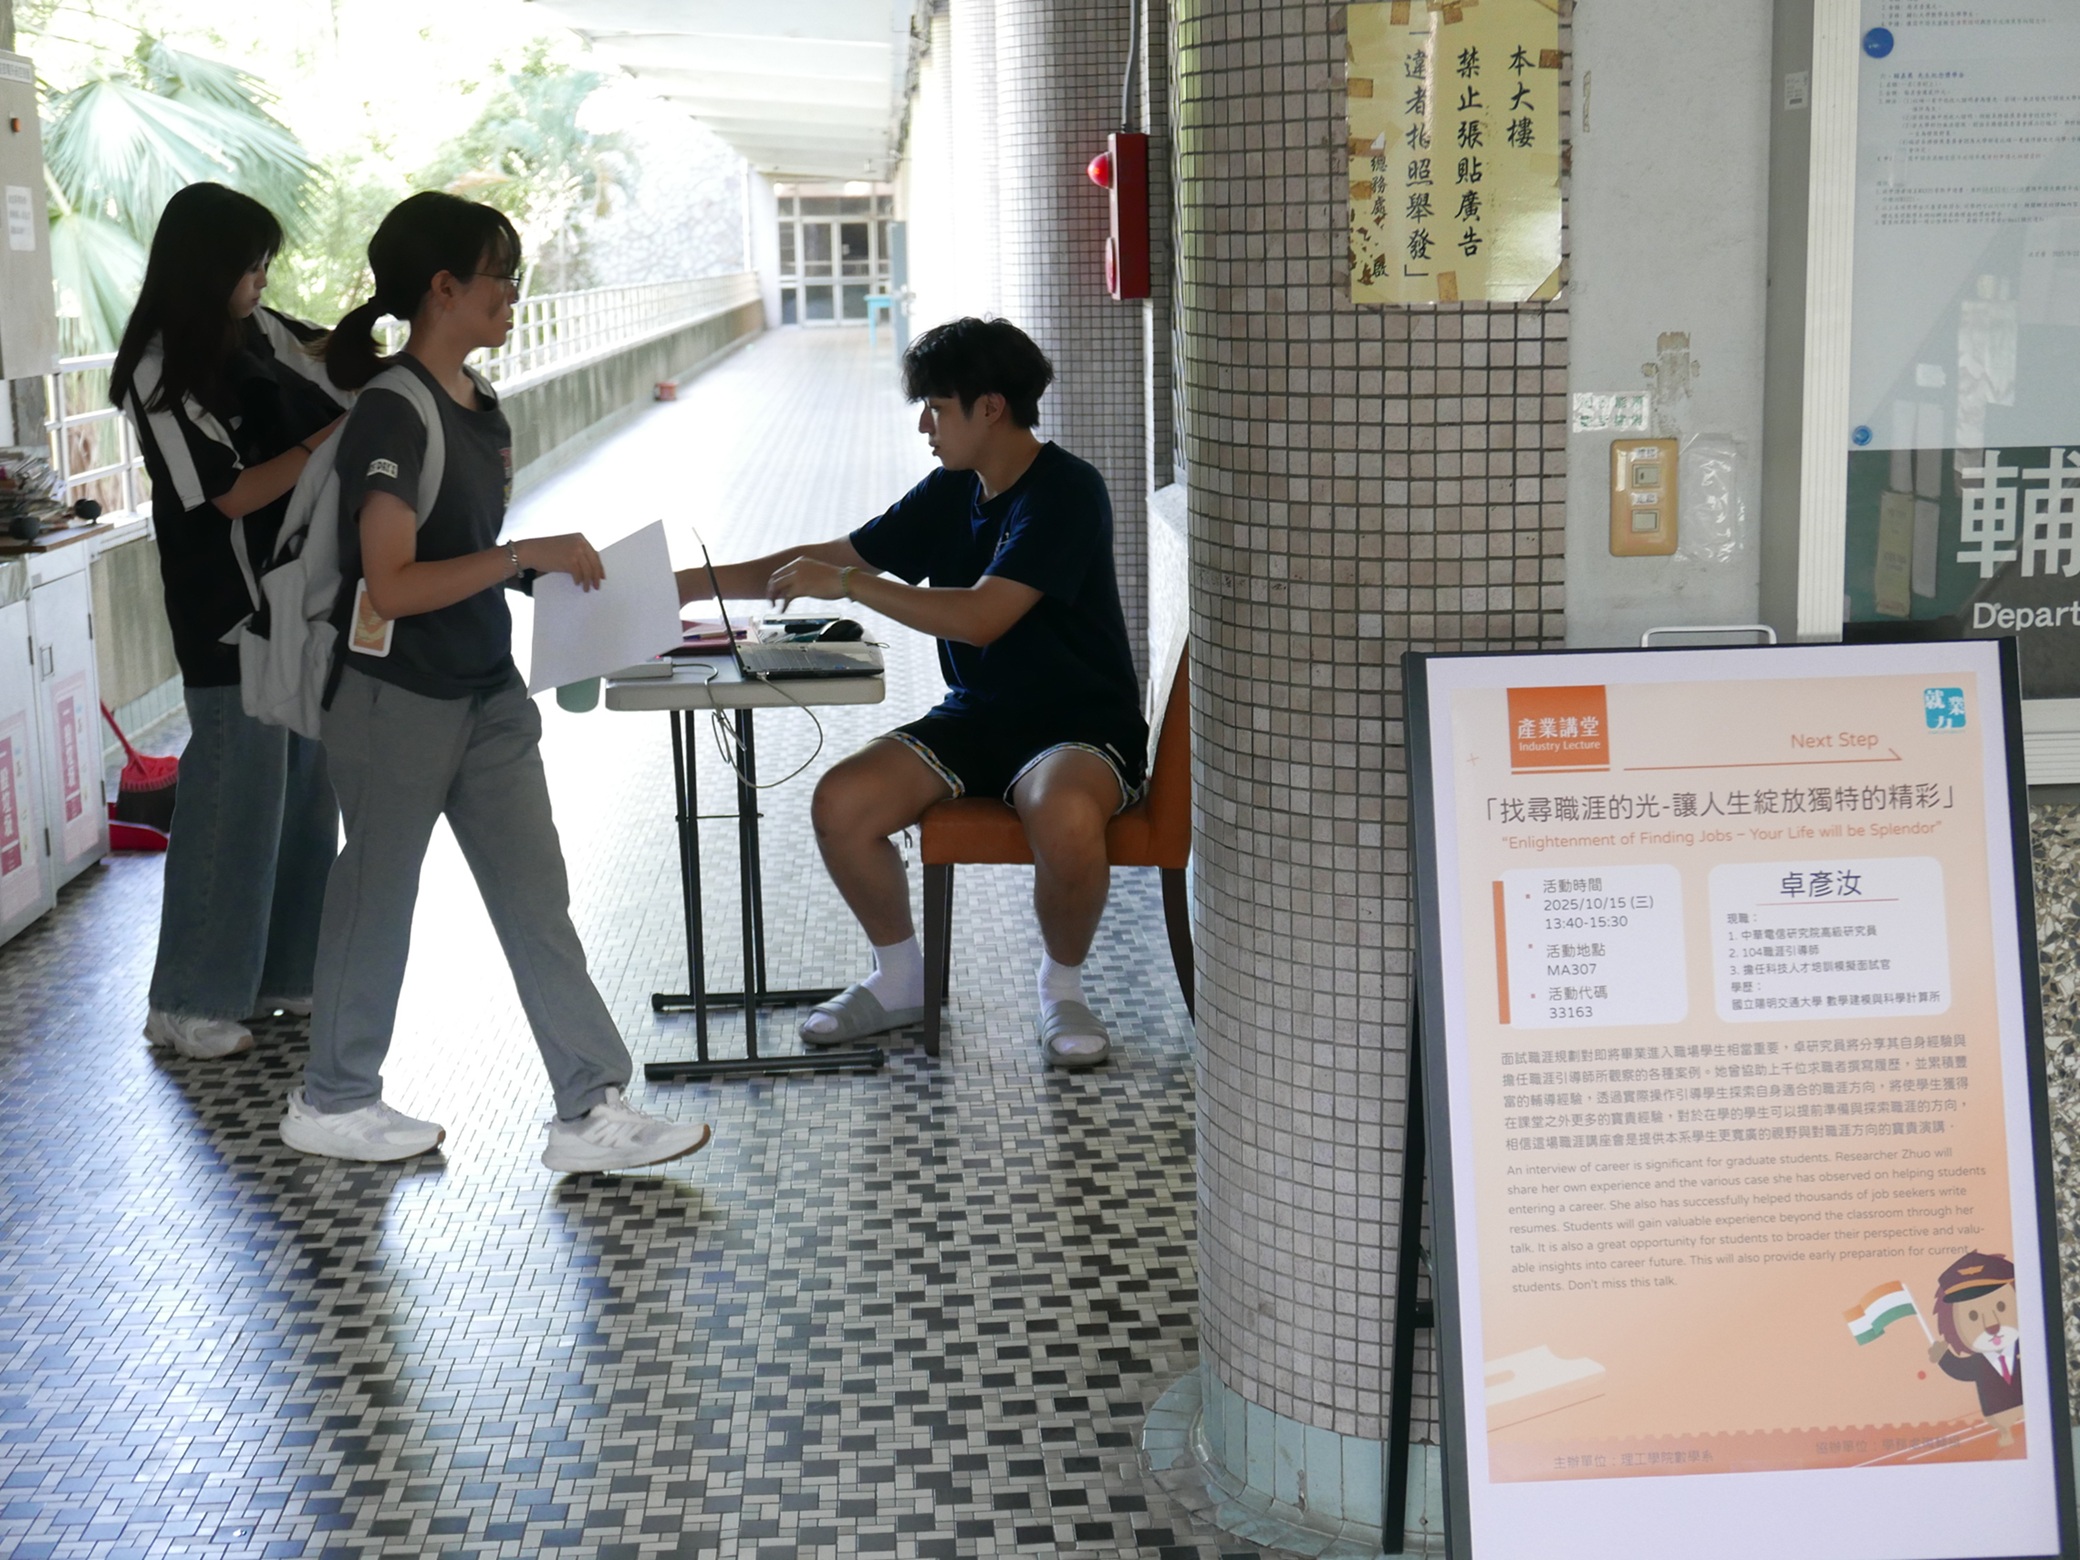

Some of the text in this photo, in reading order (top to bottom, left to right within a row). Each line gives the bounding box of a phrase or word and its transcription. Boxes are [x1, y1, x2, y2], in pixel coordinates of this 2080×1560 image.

[1507, 44, 1536, 149] 本大樓
[1454, 46, 1483, 257] 禁止張貼廣告
[1517, 715, 1599, 740] 產業講堂
[1518, 740, 1600, 752] Industry Lecture
[1790, 731, 1879, 749] Next Step
[1619, 831, 1635, 845] of
[1639, 831, 1694, 847] Finding
[1698, 829, 1733, 843] Jobs
[1748, 827, 1783, 840] Your
[1787, 825, 1814, 839] Life
[1818, 824, 1842, 837] will
[1846, 824, 1865, 837] be
[1543, 877, 1602, 893] 活動時間
[1780, 869, 1861, 897] 卓彥汝
[1543, 895, 1654, 911] 2025/10/15 (三)
[1545, 915, 1628, 929] 13:40-15:30
[1728, 931, 1738, 941] 1.
[1546, 942, 1605, 958] 活動地點
[1728, 947, 1739, 958] 2.
[1547, 962, 1597, 976] MA307
[1729, 965, 1741, 975] 3.
[1548, 984, 1607, 1001] 活動代碼
[1549, 1005, 1593, 1019] 33163
[1506, 1147, 1952, 1175] An interview of career is significant for graduate students. Researcher Zhuo will
[1506, 1166, 1986, 1195] share her own experience and the various case she has observed on helping students
[1507, 1186, 1967, 1216] entering a career. She also has successfully helped thousands of job seekers write
[1508, 1205, 1974, 1234] resumes. Students will gain valuable experience beyond the classroom through her
[1509, 1223, 1985, 1254] talk. It is also a great opportunity for students to broader their perspective and valu-
[1511, 1245, 1969, 1274] able insights into career future. This will also provide early preparation for current
[1511, 1275, 1678, 1293] students. Don't miss this talk.
